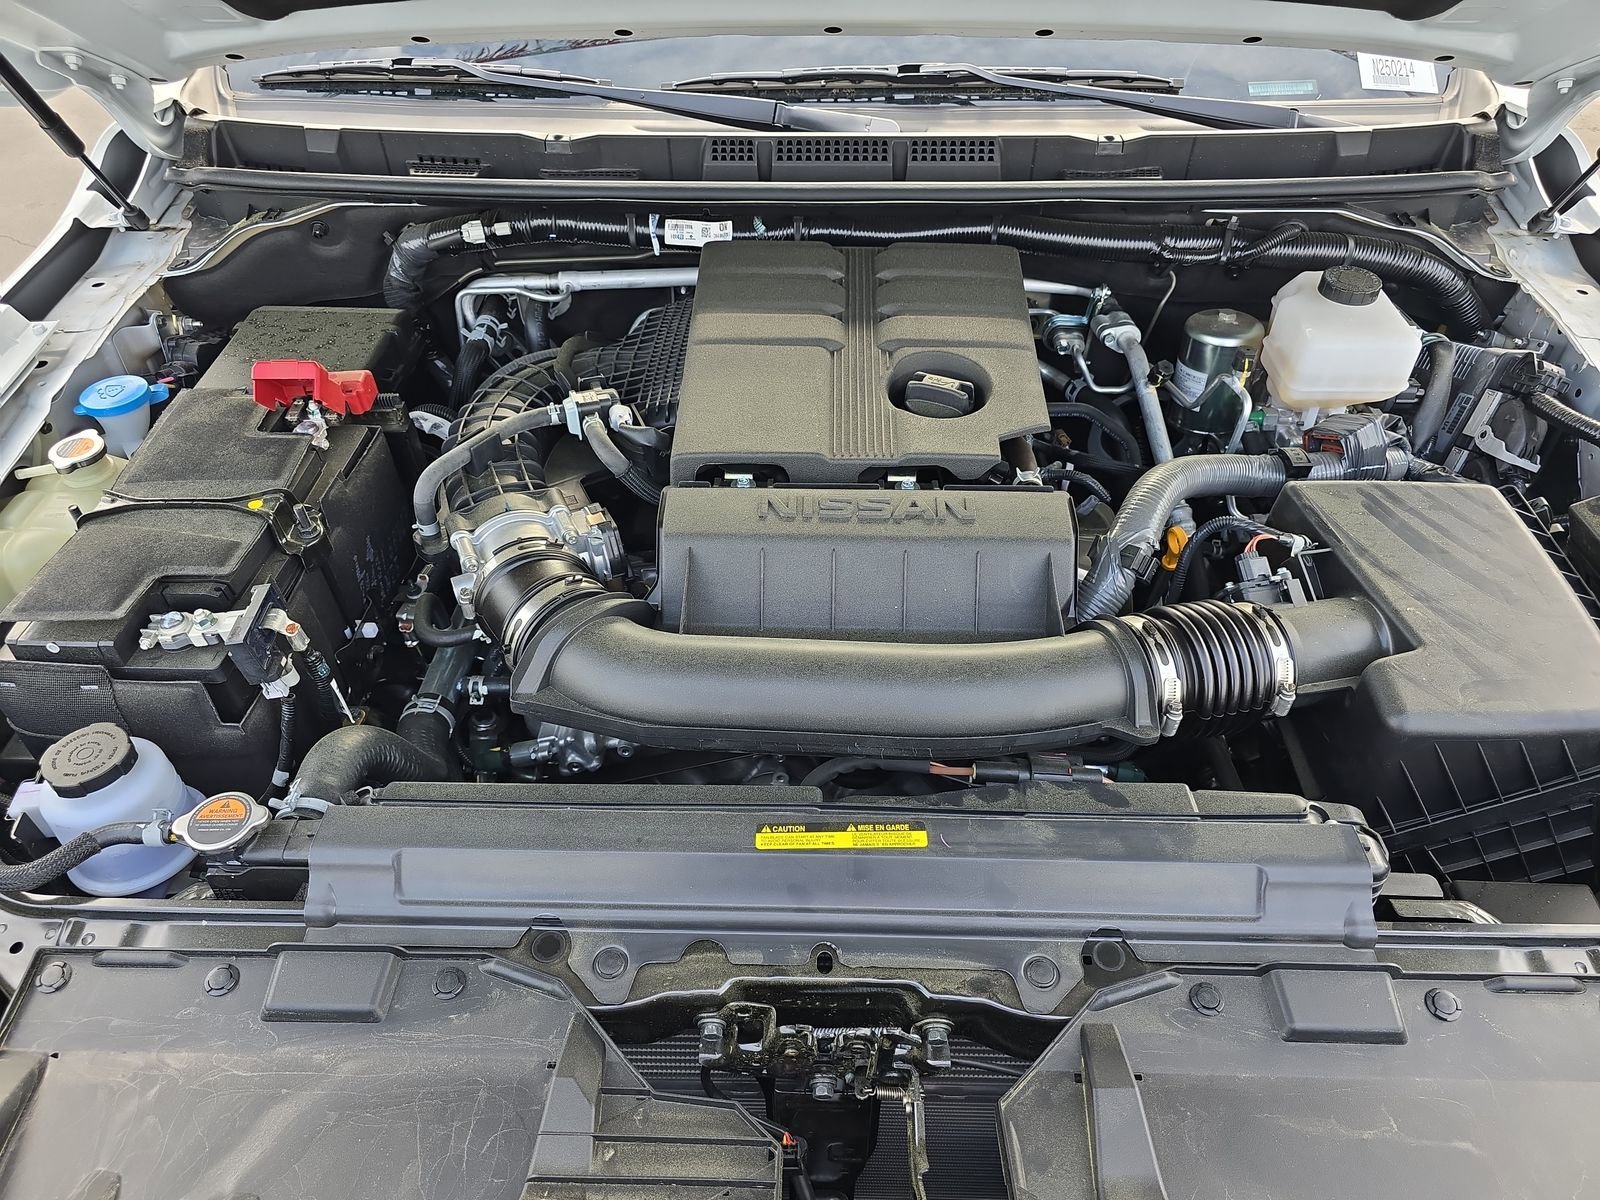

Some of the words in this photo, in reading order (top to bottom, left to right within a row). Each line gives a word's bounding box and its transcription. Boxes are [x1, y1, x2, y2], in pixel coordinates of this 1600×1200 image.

[1372, 58, 1415, 78] N250214
[758, 496, 977, 525] NISSAN
[772, 825, 806, 833] CAUTION
